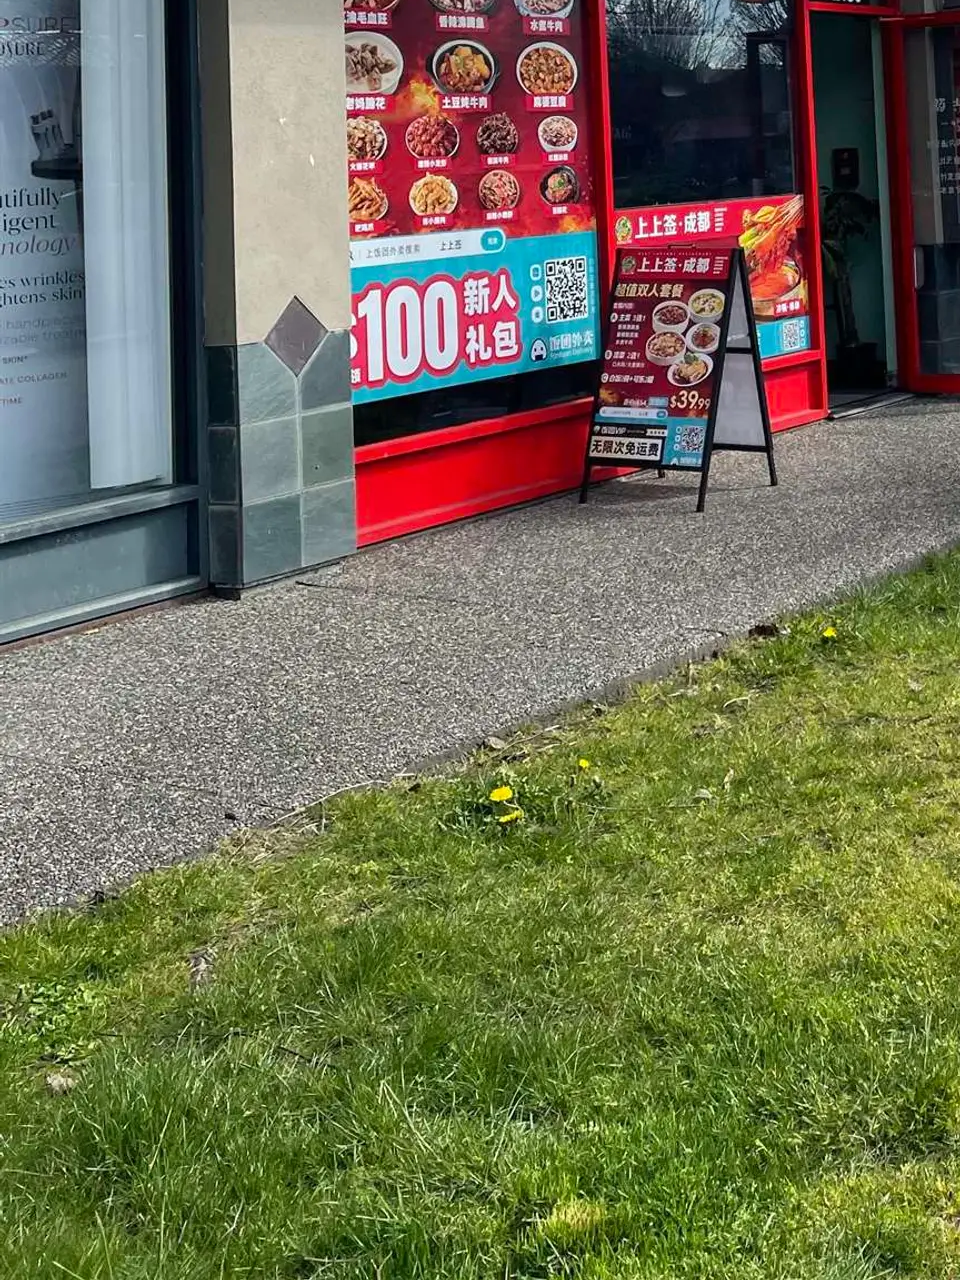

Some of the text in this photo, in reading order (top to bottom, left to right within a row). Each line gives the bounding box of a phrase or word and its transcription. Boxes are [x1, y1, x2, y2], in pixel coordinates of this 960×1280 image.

[0, 16, 77, 33] SURE
[464, 274, 517, 316] 新人
[615, 283, 684, 297] 超值双人套餐
[465, 321, 518, 363] 礼包
[670, 390, 711, 410] $39.99
[591, 439, 659, 457] 无限次免运费
